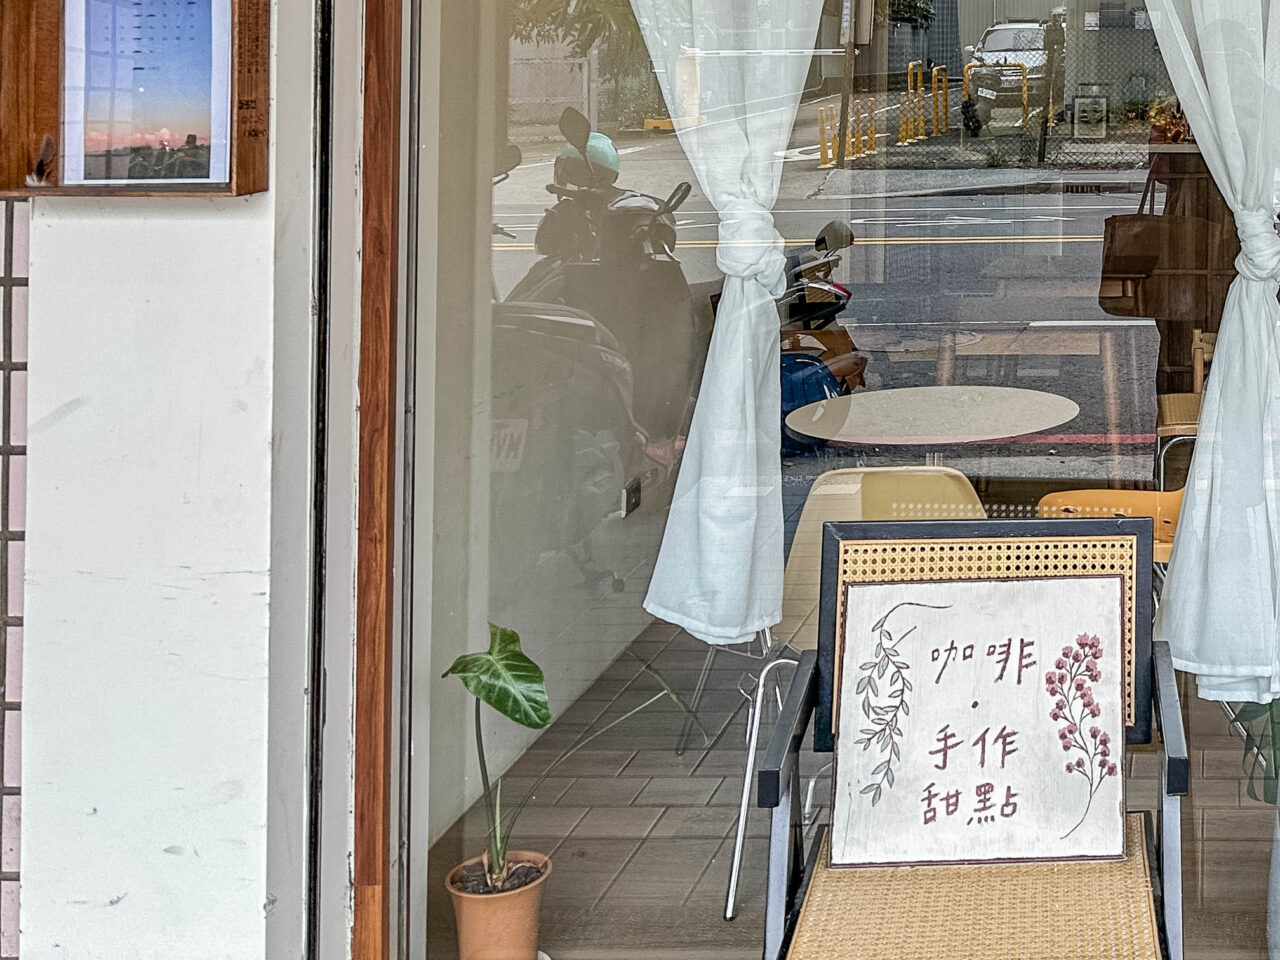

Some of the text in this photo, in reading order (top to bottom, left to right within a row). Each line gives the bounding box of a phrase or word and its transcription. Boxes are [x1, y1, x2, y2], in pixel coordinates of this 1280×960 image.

[930, 637, 1038, 685] 咖啡
[928, 723, 1019, 770] 手作
[920, 782, 1019, 826] 甜點
